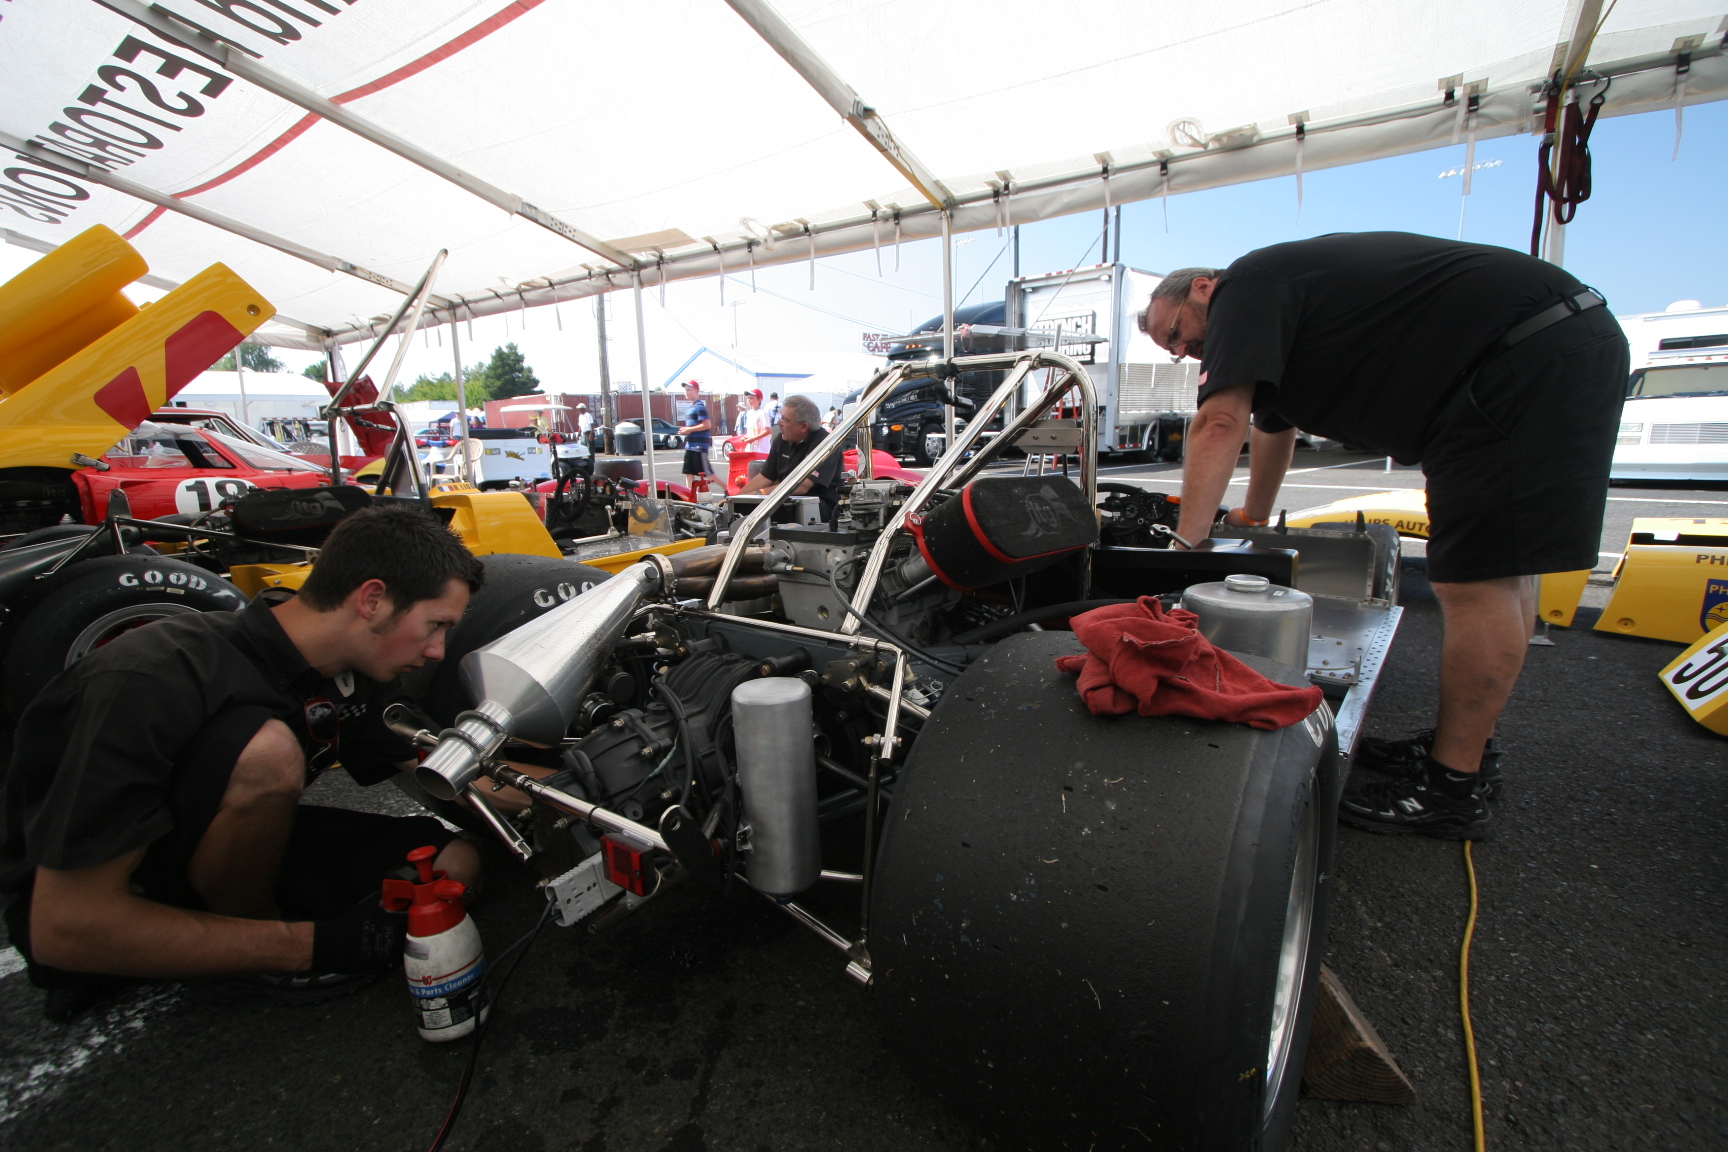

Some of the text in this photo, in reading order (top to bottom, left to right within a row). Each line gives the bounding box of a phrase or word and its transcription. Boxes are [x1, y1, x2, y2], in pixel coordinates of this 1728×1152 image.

[1696, 554, 1728, 566] PH
[119, 570, 207, 590] GOOD
[421, 987, 443, 996] Parts
[444, 973, 474, 991] Cleaner
